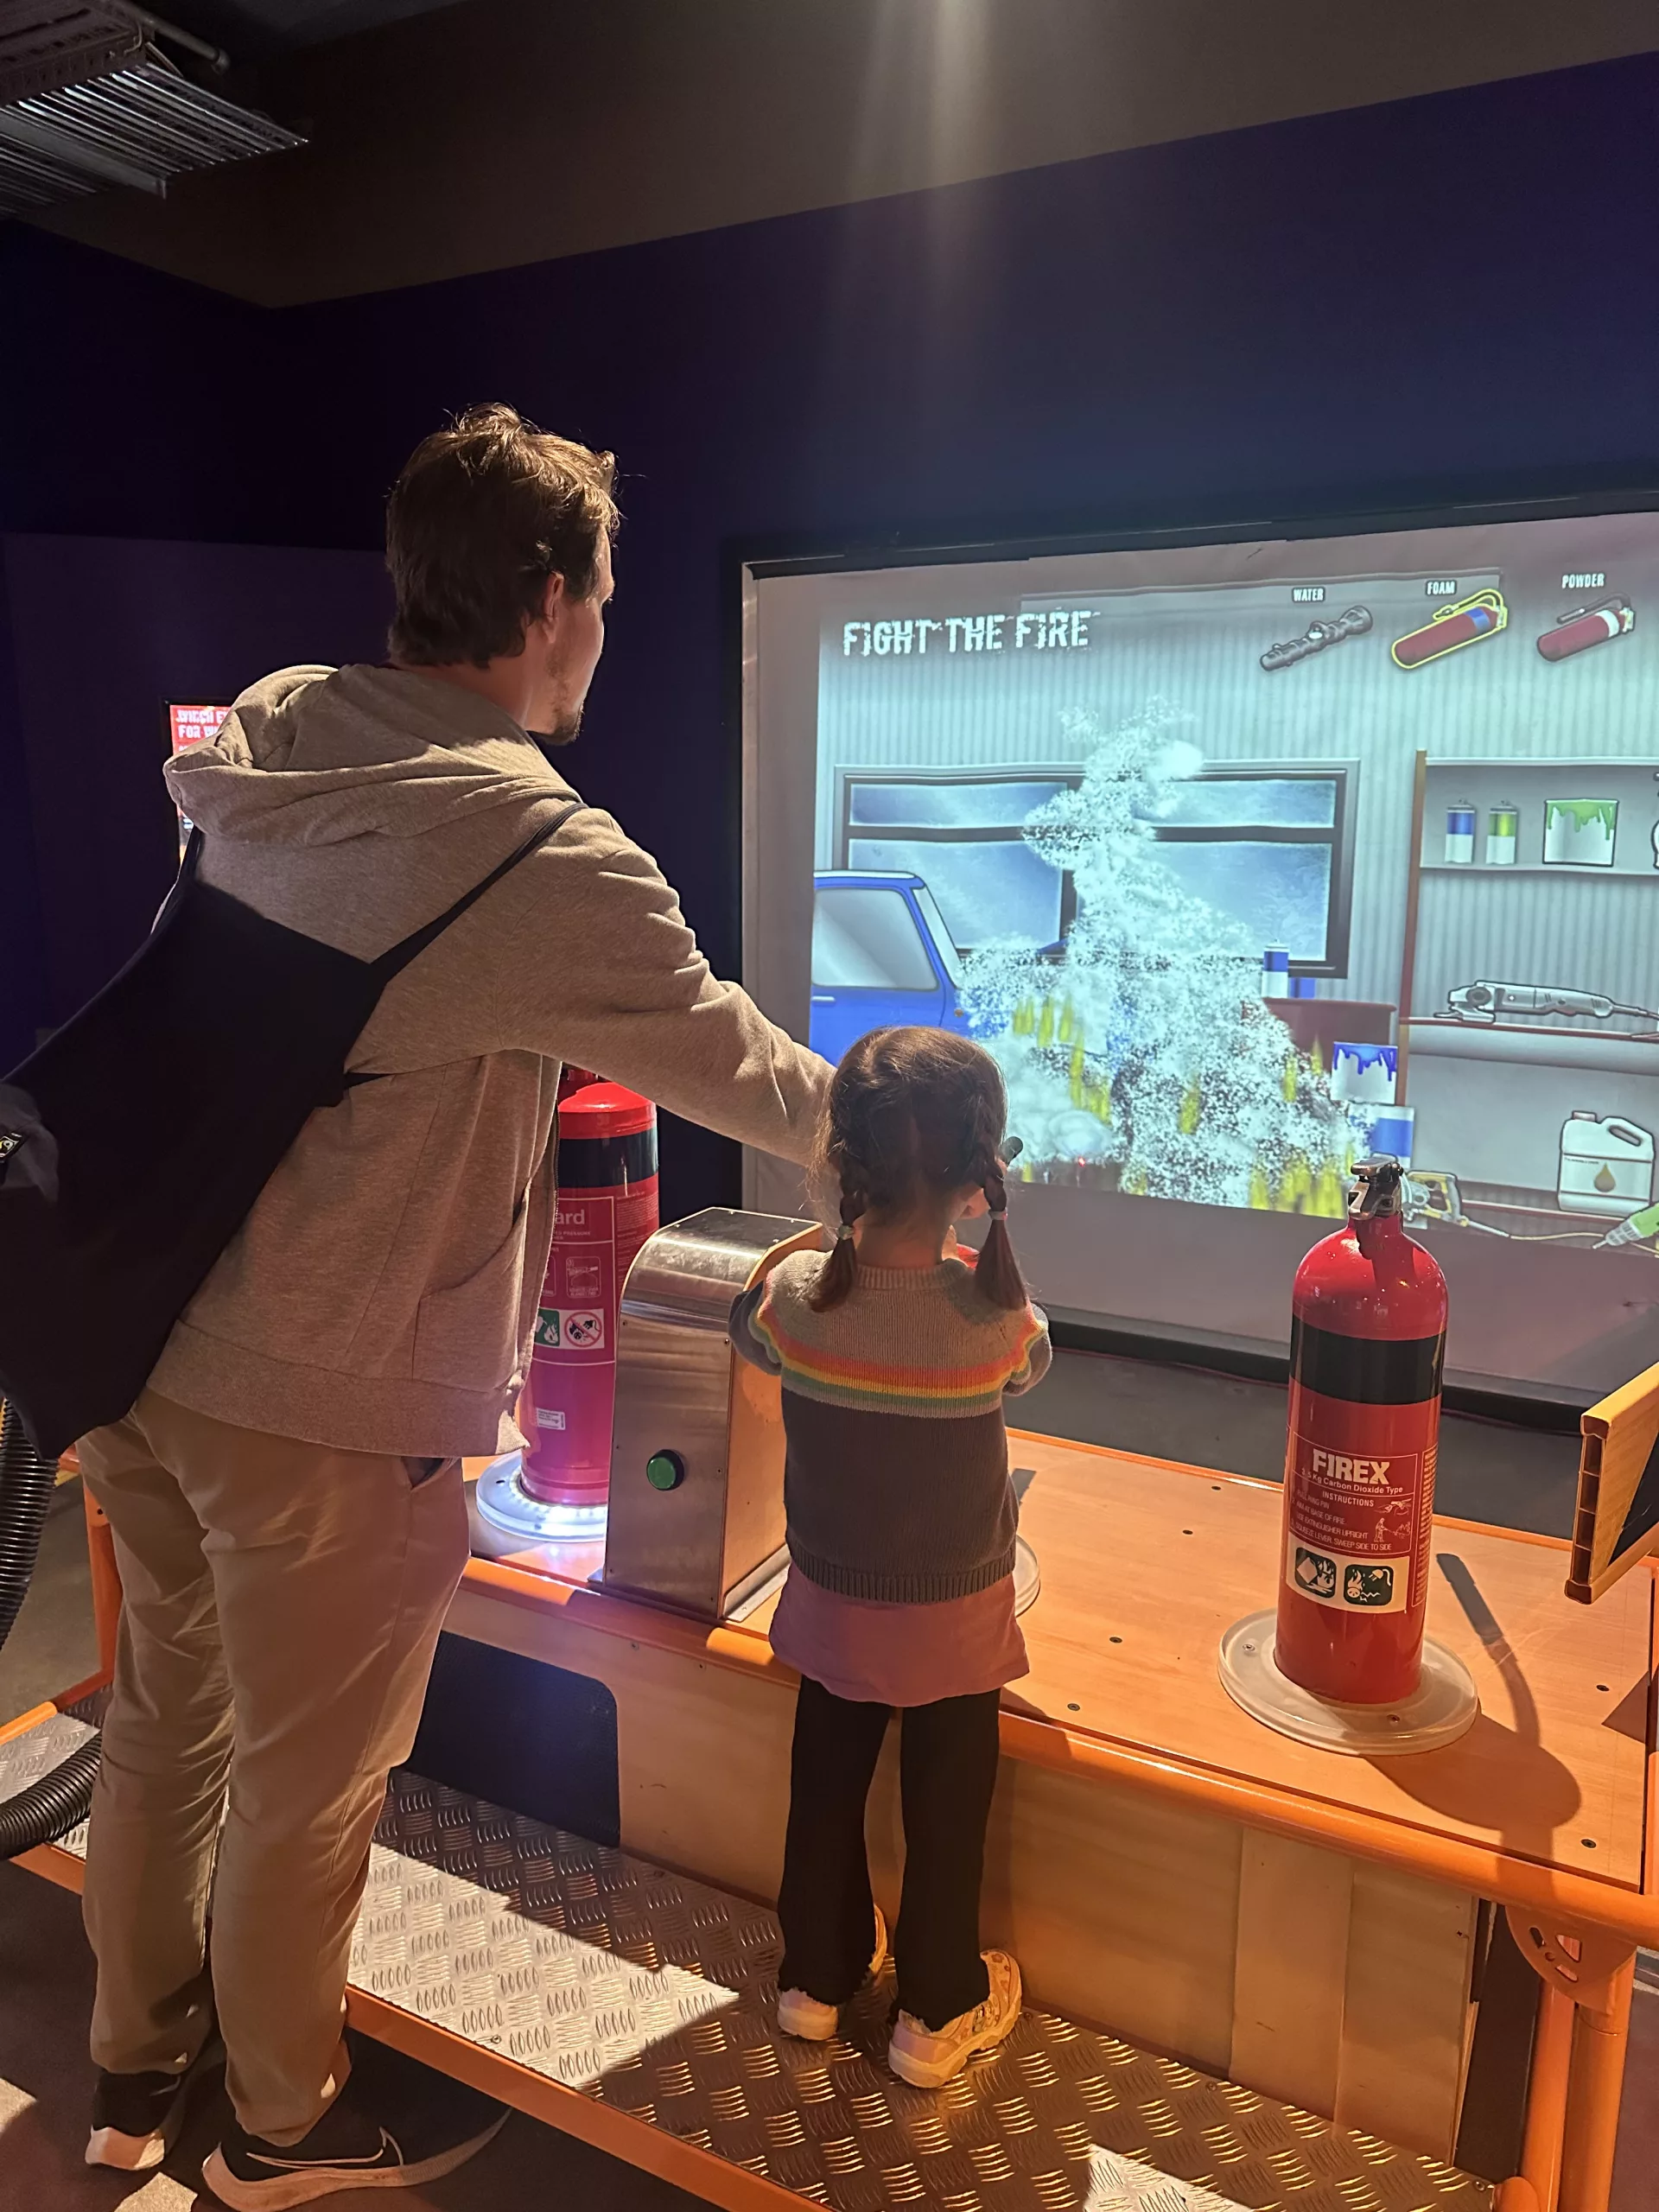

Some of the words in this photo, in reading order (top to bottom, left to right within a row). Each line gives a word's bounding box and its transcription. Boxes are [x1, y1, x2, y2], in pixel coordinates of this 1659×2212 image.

[1427, 582, 1455, 594] FOAM
[1561, 574, 1605, 588] POWDER
[1294, 588, 1324, 602] WATER
[843, 619, 943, 657] FIGHT
[945, 614, 1014, 653] THE
[1015, 607, 1100, 650] FIRE
[178, 725, 201, 739] FOR
[554, 1210, 585, 1224] ard
[1313, 1448, 1390, 1484] FIREX
[1323, 1478, 1352, 1491] Carbon
[1353, 1484, 1384, 1494] Dioxide
[1386, 1486, 1403, 1495] Type
[1322, 1491, 1374, 1507] INSTRUCTIONS
[1342, 1529, 1369, 1539] UPRIGHT
[1333, 1537, 1355, 1548] SWEEP
[1356, 1542, 1370, 1551] SIDE
